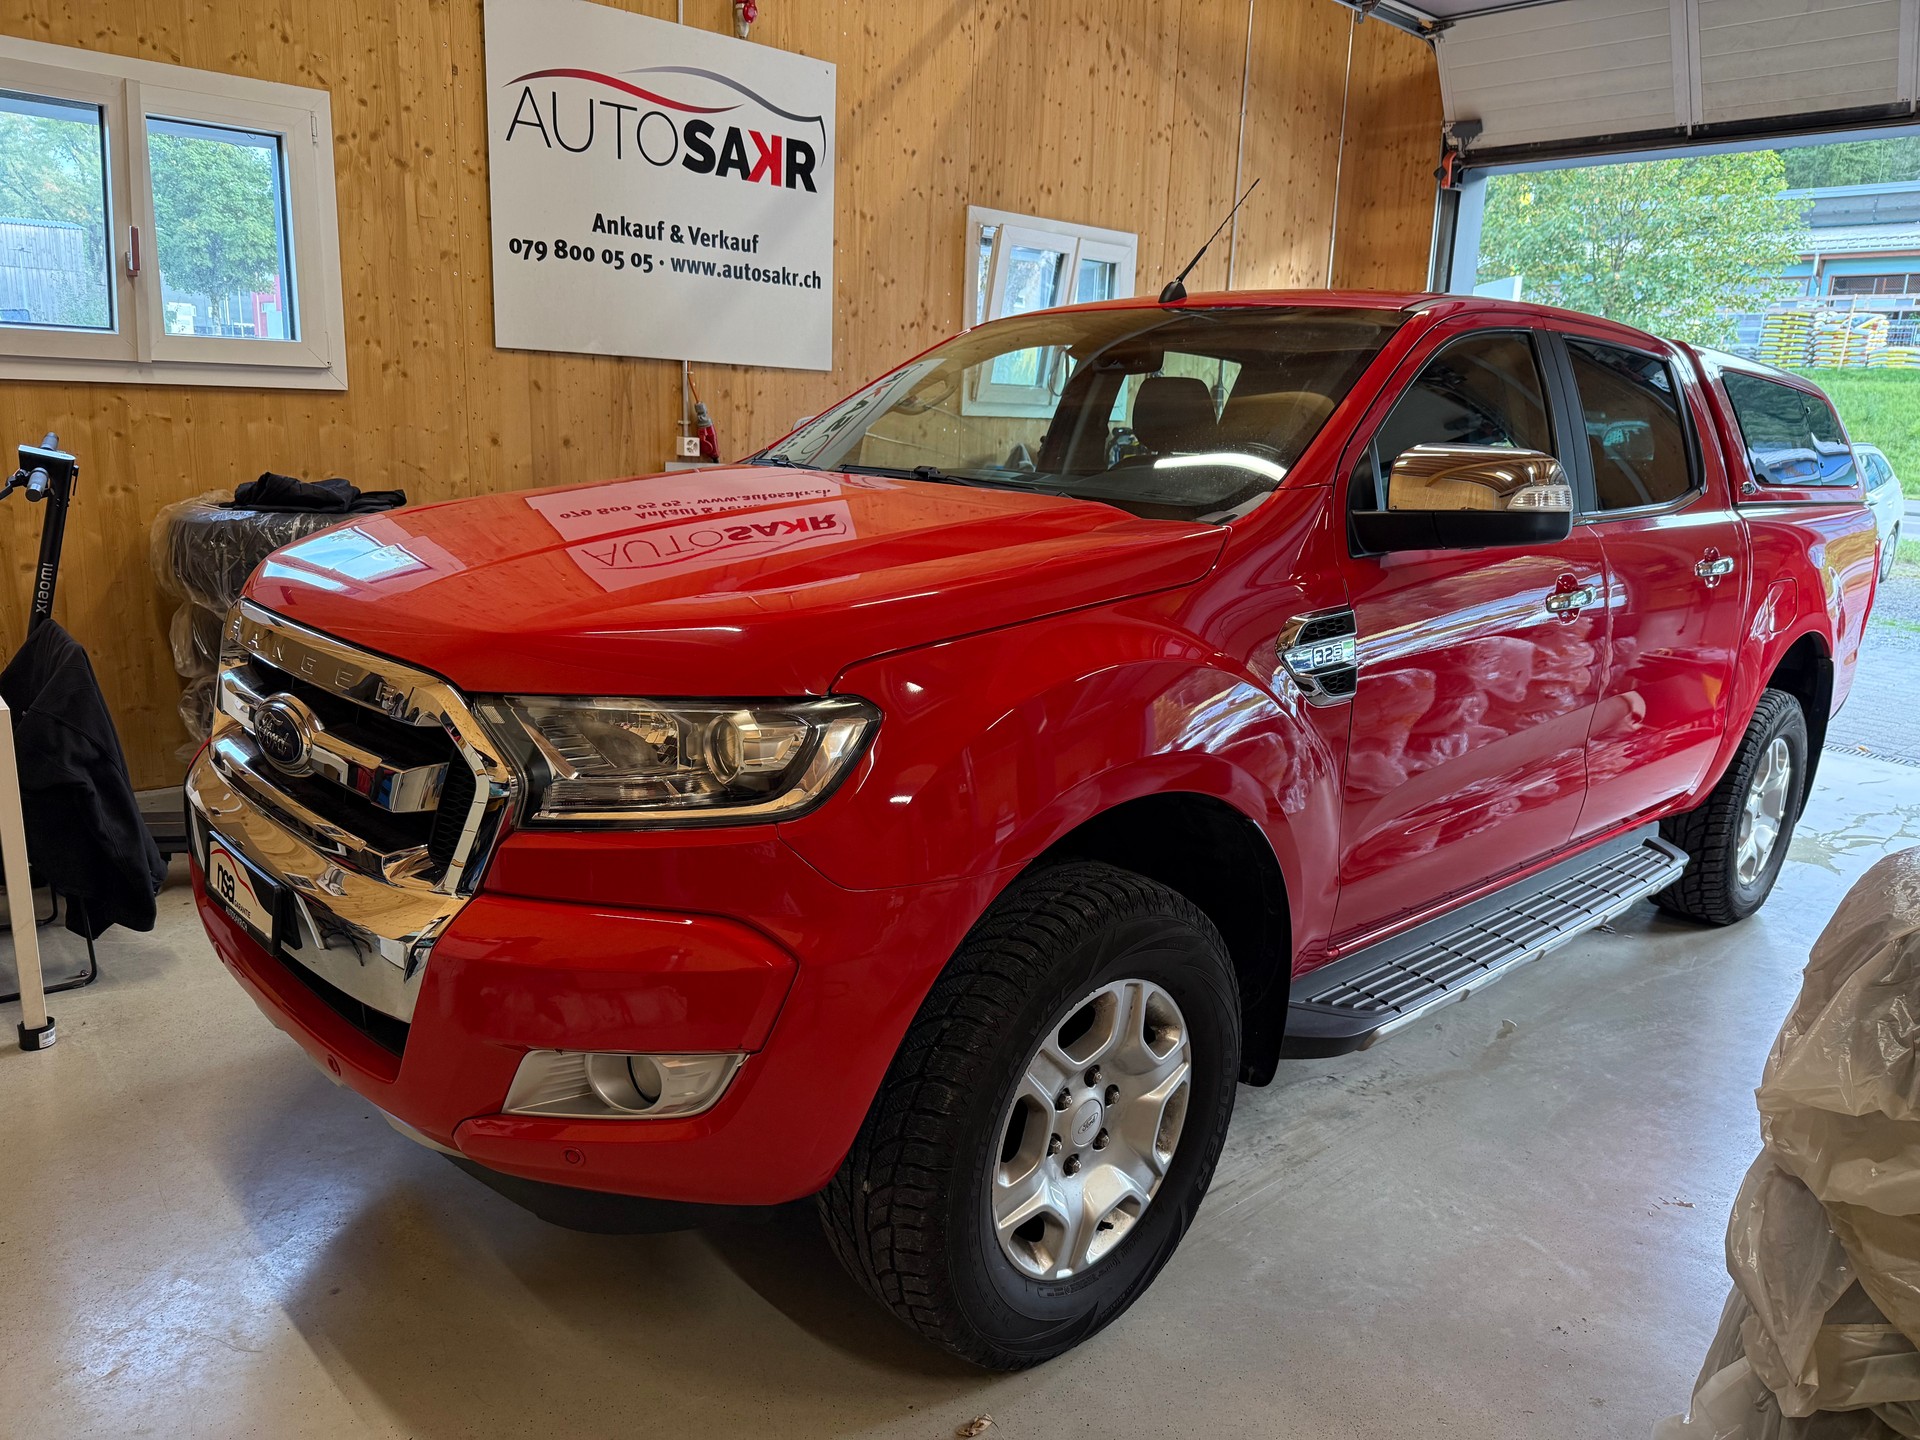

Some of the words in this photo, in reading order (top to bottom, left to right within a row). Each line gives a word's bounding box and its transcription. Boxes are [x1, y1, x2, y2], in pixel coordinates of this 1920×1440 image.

[505, 86, 818, 193] AUTOSAKR
[592, 212, 664, 241] Ankauf
[670, 224, 685, 243] &
[688, 225, 760, 254] Verkauf
[509, 237, 547, 262] 079
[553, 239, 595, 262] 800
[601, 249, 625, 270] 05
[630, 252, 654, 273] 05
[670, 255, 822, 289] www.autosakr.ch
[36, 562, 54, 614] xiaomi
[230, 616, 398, 708] RANGER
[259, 711, 293, 756] Ford
[217, 862, 235, 905] nsa
